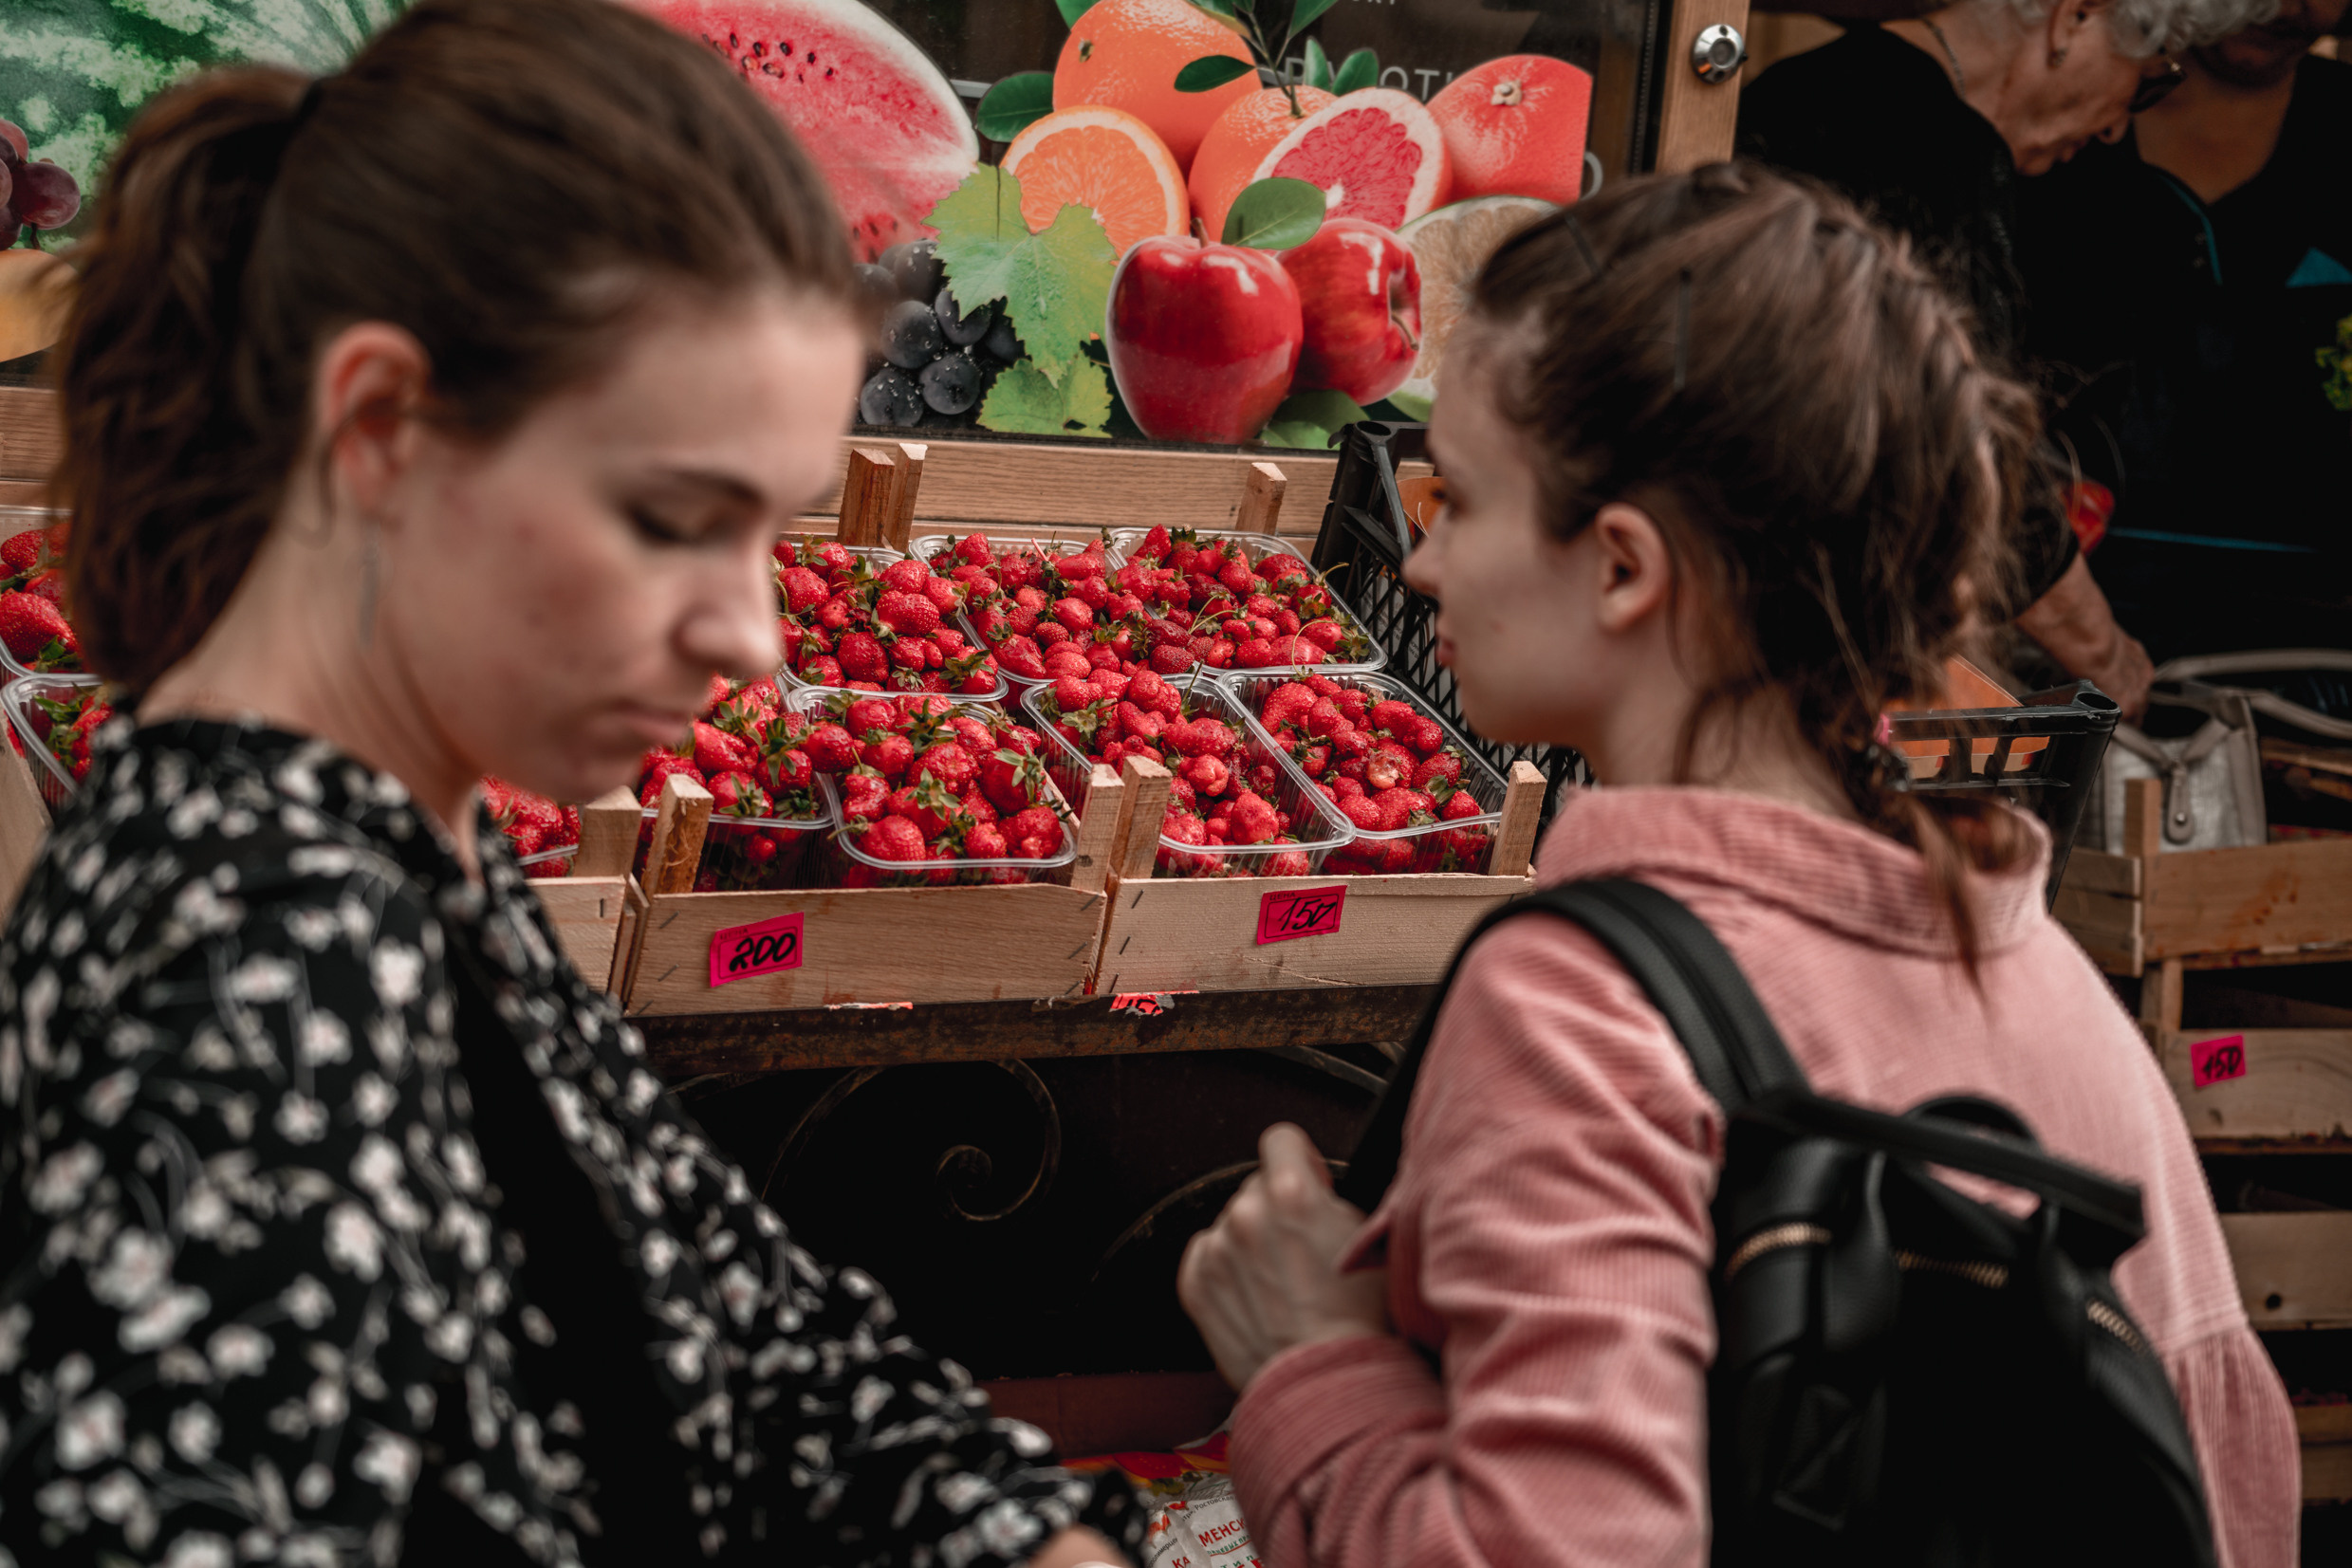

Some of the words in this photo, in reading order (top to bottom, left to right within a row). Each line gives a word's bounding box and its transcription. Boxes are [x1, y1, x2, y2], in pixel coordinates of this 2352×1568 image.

[1278, 897, 1337, 932] 150
[730, 932, 796, 971] 200
[2203, 1046, 2241, 1079] 150
